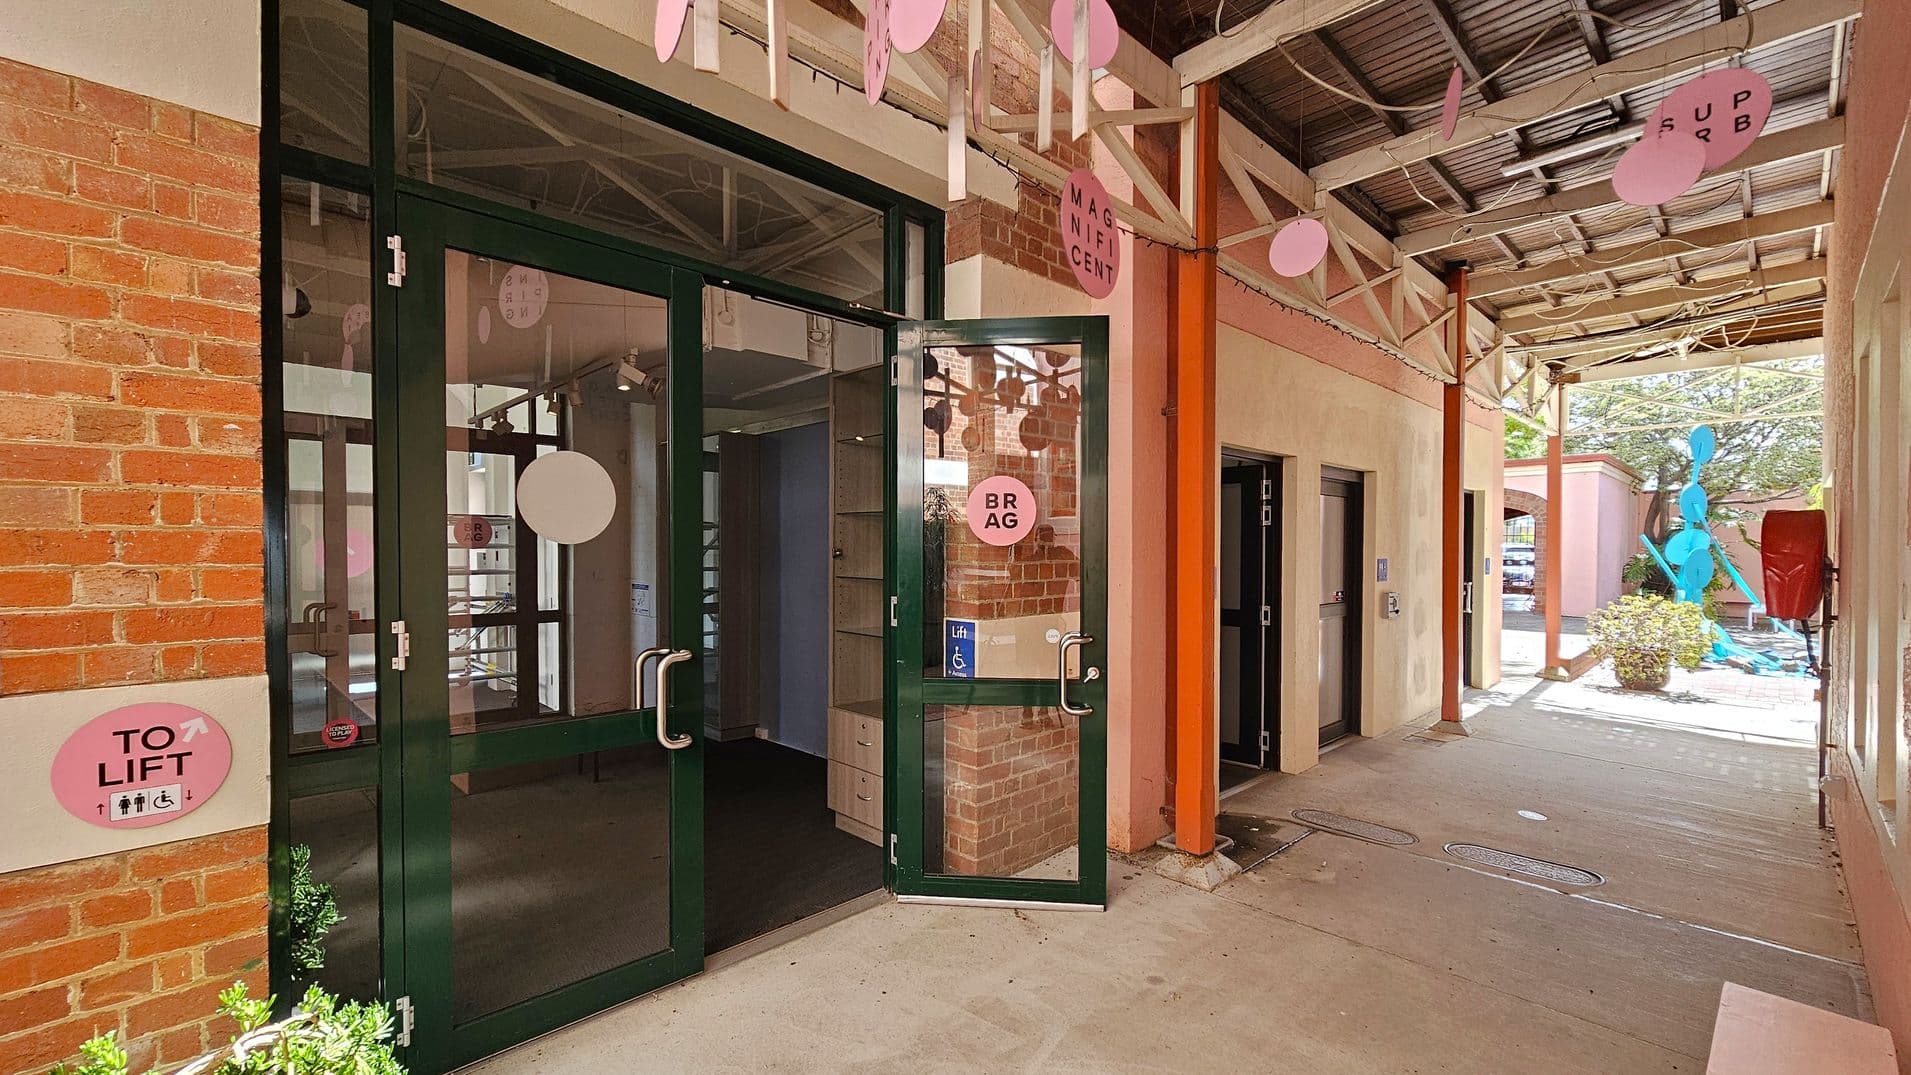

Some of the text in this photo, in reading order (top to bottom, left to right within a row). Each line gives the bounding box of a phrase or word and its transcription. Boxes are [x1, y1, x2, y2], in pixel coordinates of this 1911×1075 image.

[1660, 90, 1751, 132] SUP
[1659, 114, 1751, 142] RB
[1071, 182, 1112, 229] MAG
[1071, 213, 1112, 257] NIFI
[1071, 245, 1113, 285] CENT
[985, 493, 1017, 509] BR
[463, 522, 482, 532] BR
[984, 512, 1018, 529] AG
[465, 532, 483, 542] AG
[952, 625, 967, 639] Lift
[326, 724, 355, 733] LICENSED
[337, 729, 352, 737] PLAY
[112, 726, 175, 754] TO
[98, 752, 192, 787] LIFT
